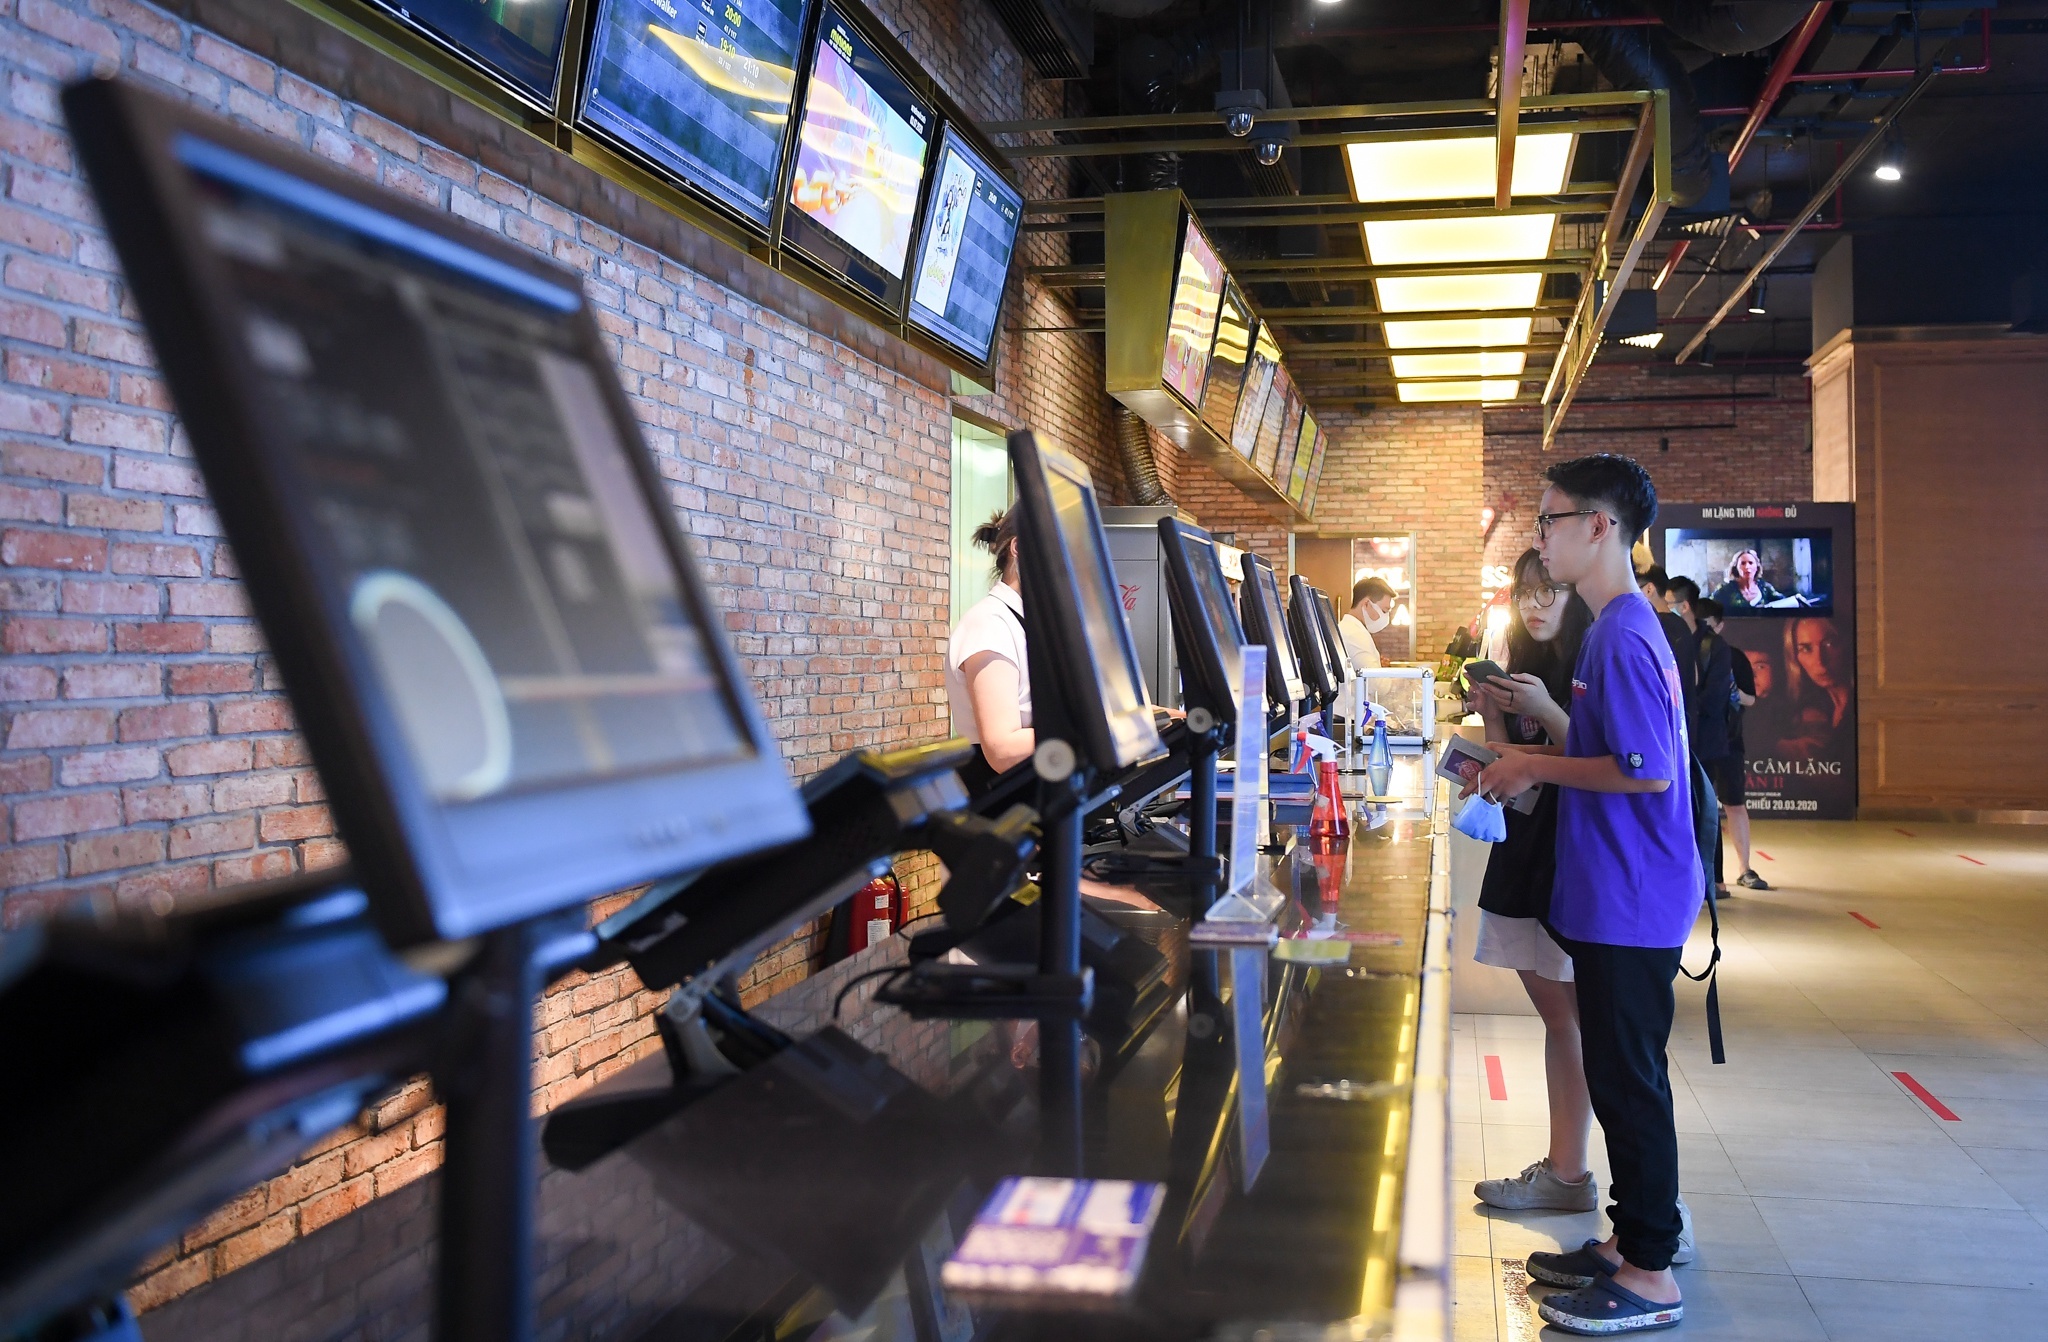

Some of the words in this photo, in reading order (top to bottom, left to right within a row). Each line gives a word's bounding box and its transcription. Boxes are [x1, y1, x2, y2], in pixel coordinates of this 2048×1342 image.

[725, 4, 742, 28] 20:00
[720, 37, 736, 59] 19:10
[743, 58, 760, 79] 21:10
[1702, 508, 1713, 518] IM
[1714, 506, 1735, 520] LẶNG
[1736, 505, 1755, 518] THÔI
[1752, 758, 1791, 774] CÂM
[1795, 757, 1841, 776] LẶNG
[1745, 797, 1771, 810] CHIẾU
[1773, 800, 1818, 811] 20.03.2020
